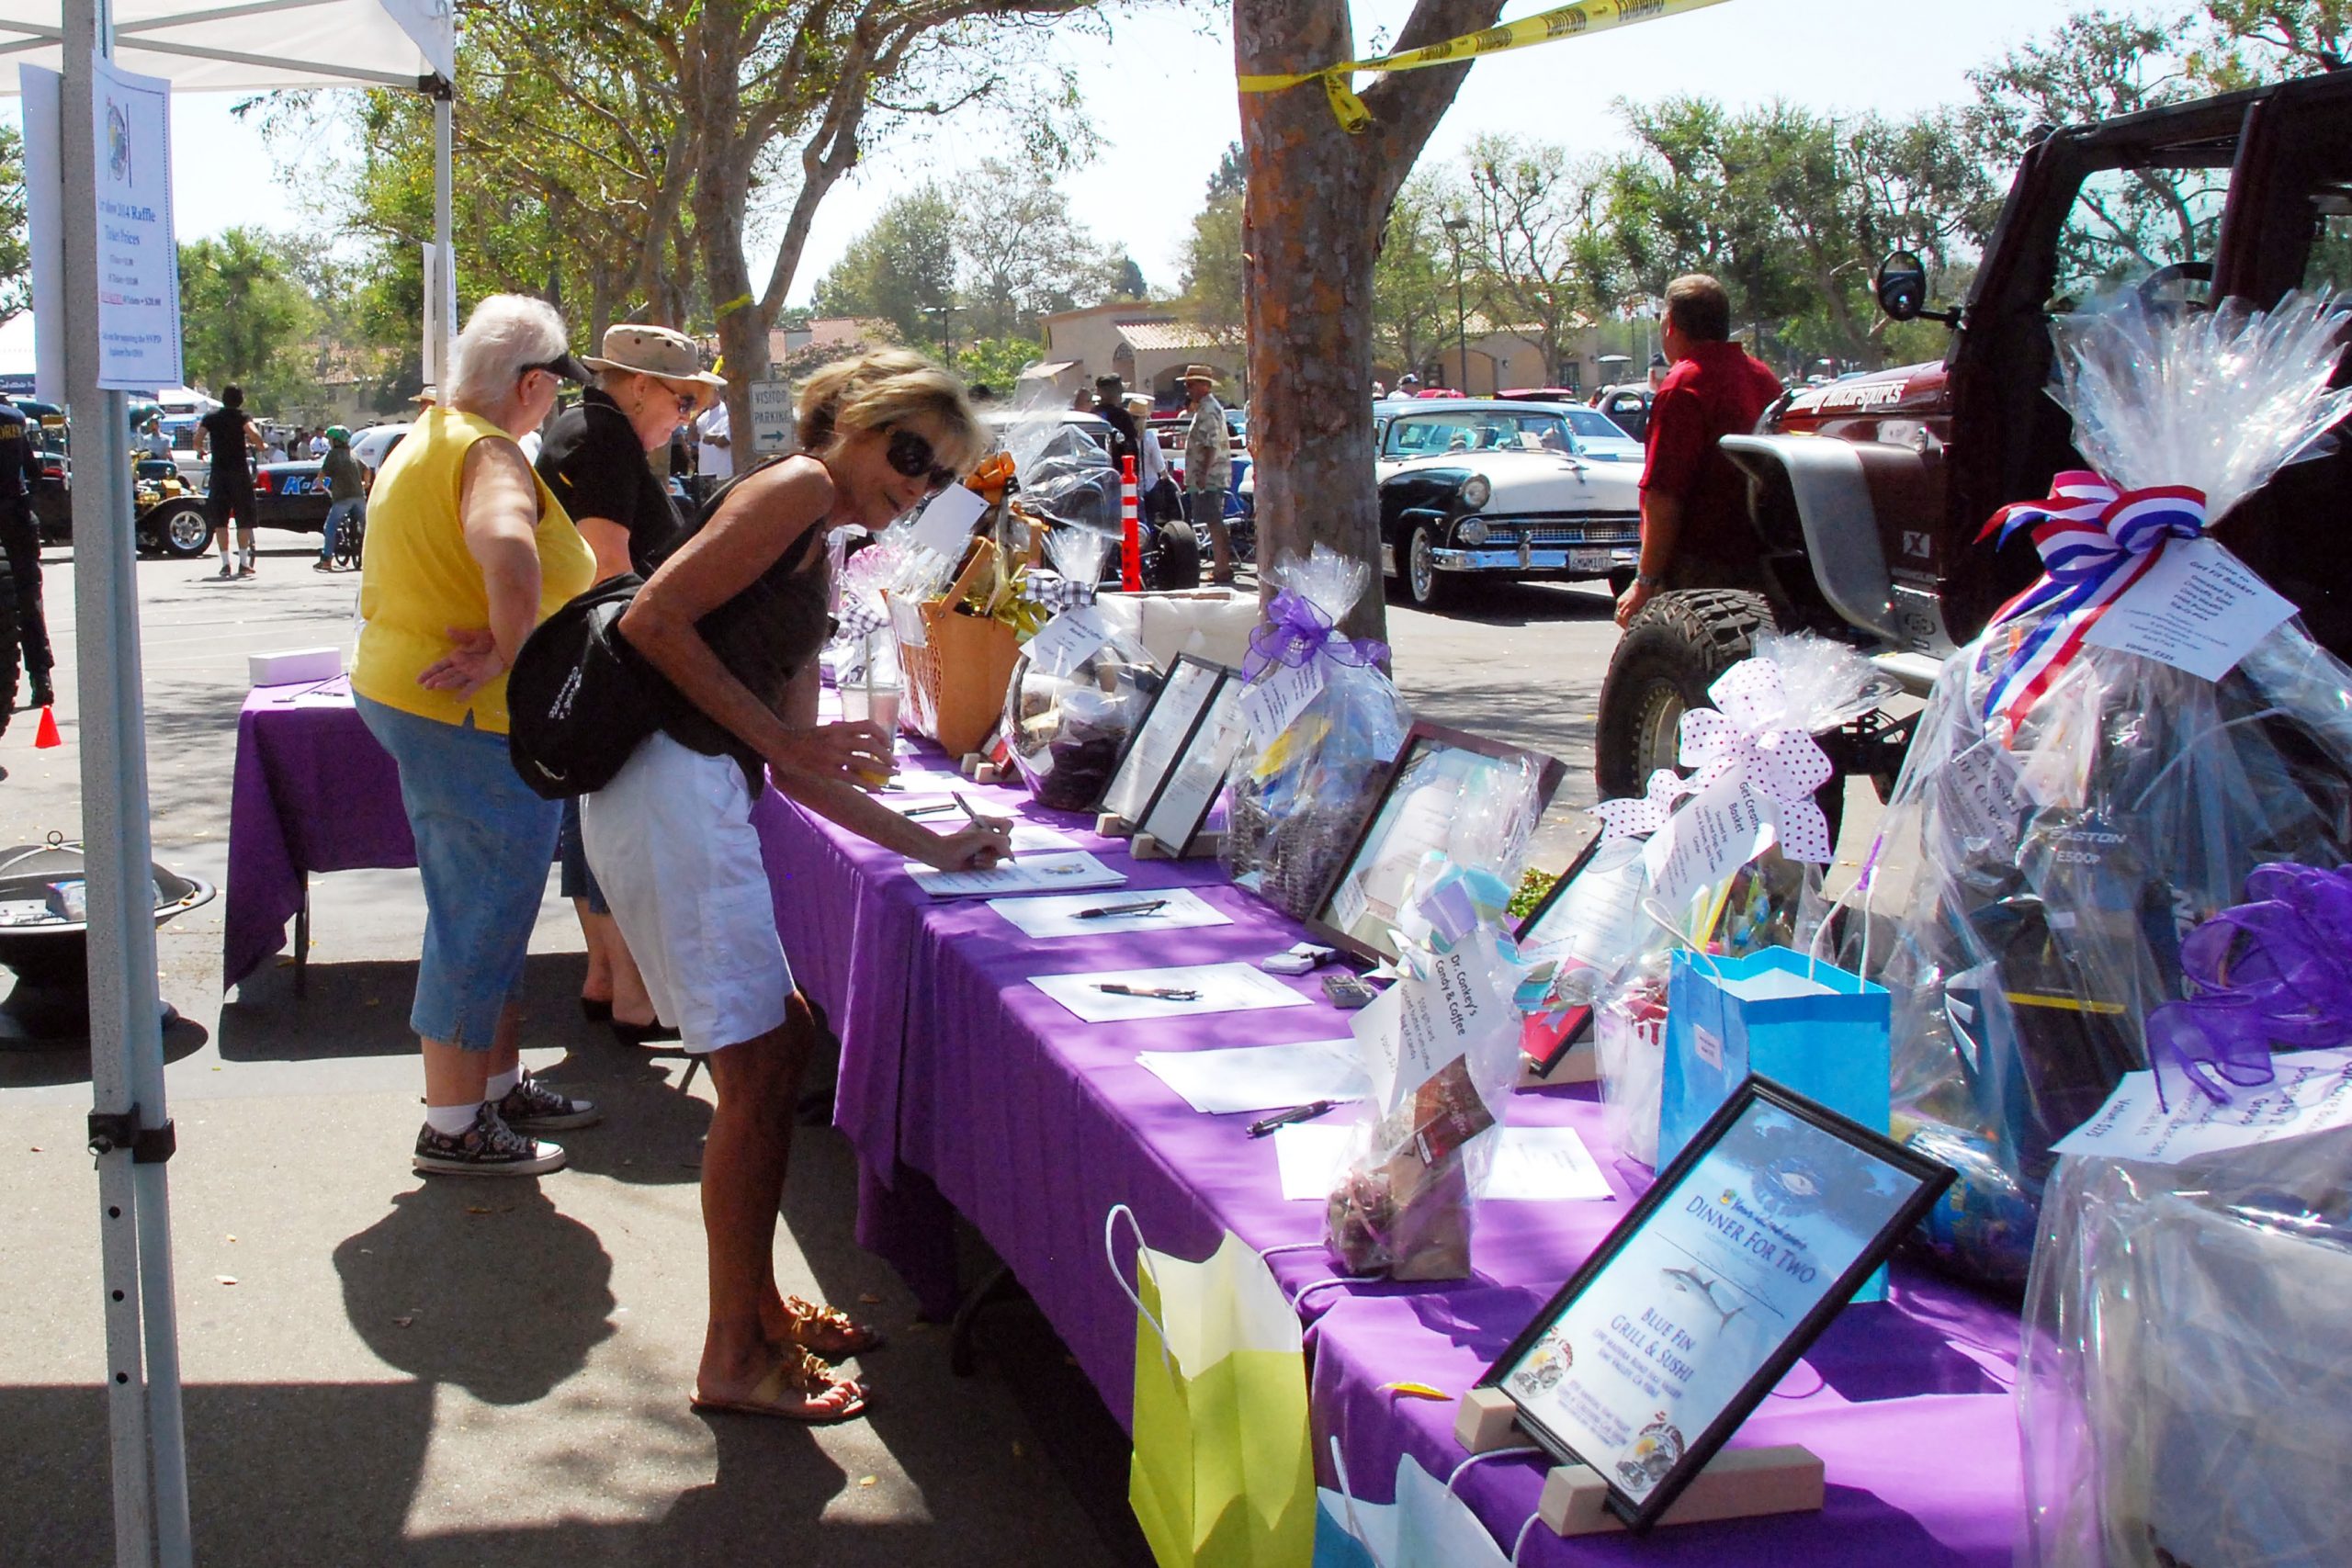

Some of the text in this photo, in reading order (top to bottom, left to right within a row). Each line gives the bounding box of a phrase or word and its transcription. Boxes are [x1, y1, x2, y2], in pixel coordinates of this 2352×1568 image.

[754, 389, 788, 404] VISITOR
[754, 410, 791, 424] PARKING
[2189, 560, 2208, 571] Get
[1739, 781, 1751, 799] Get
[1728, 802, 1744, 834] Basket
[2049, 831, 2127, 843] EASTON
[1435, 959, 1466, 1036] Candy & Coffee
[1451, 953, 1478, 1017] Dr. Conkey's
[1686, 1195, 1745, 1242] DINNER
[1743, 1230, 1777, 1261] FOR
[1776, 1248, 1816, 1284] TWO
[1641, 1307, 1697, 1352] BLUE FIN
[1611, 1314, 1695, 1383] GRILL & SUSHI
